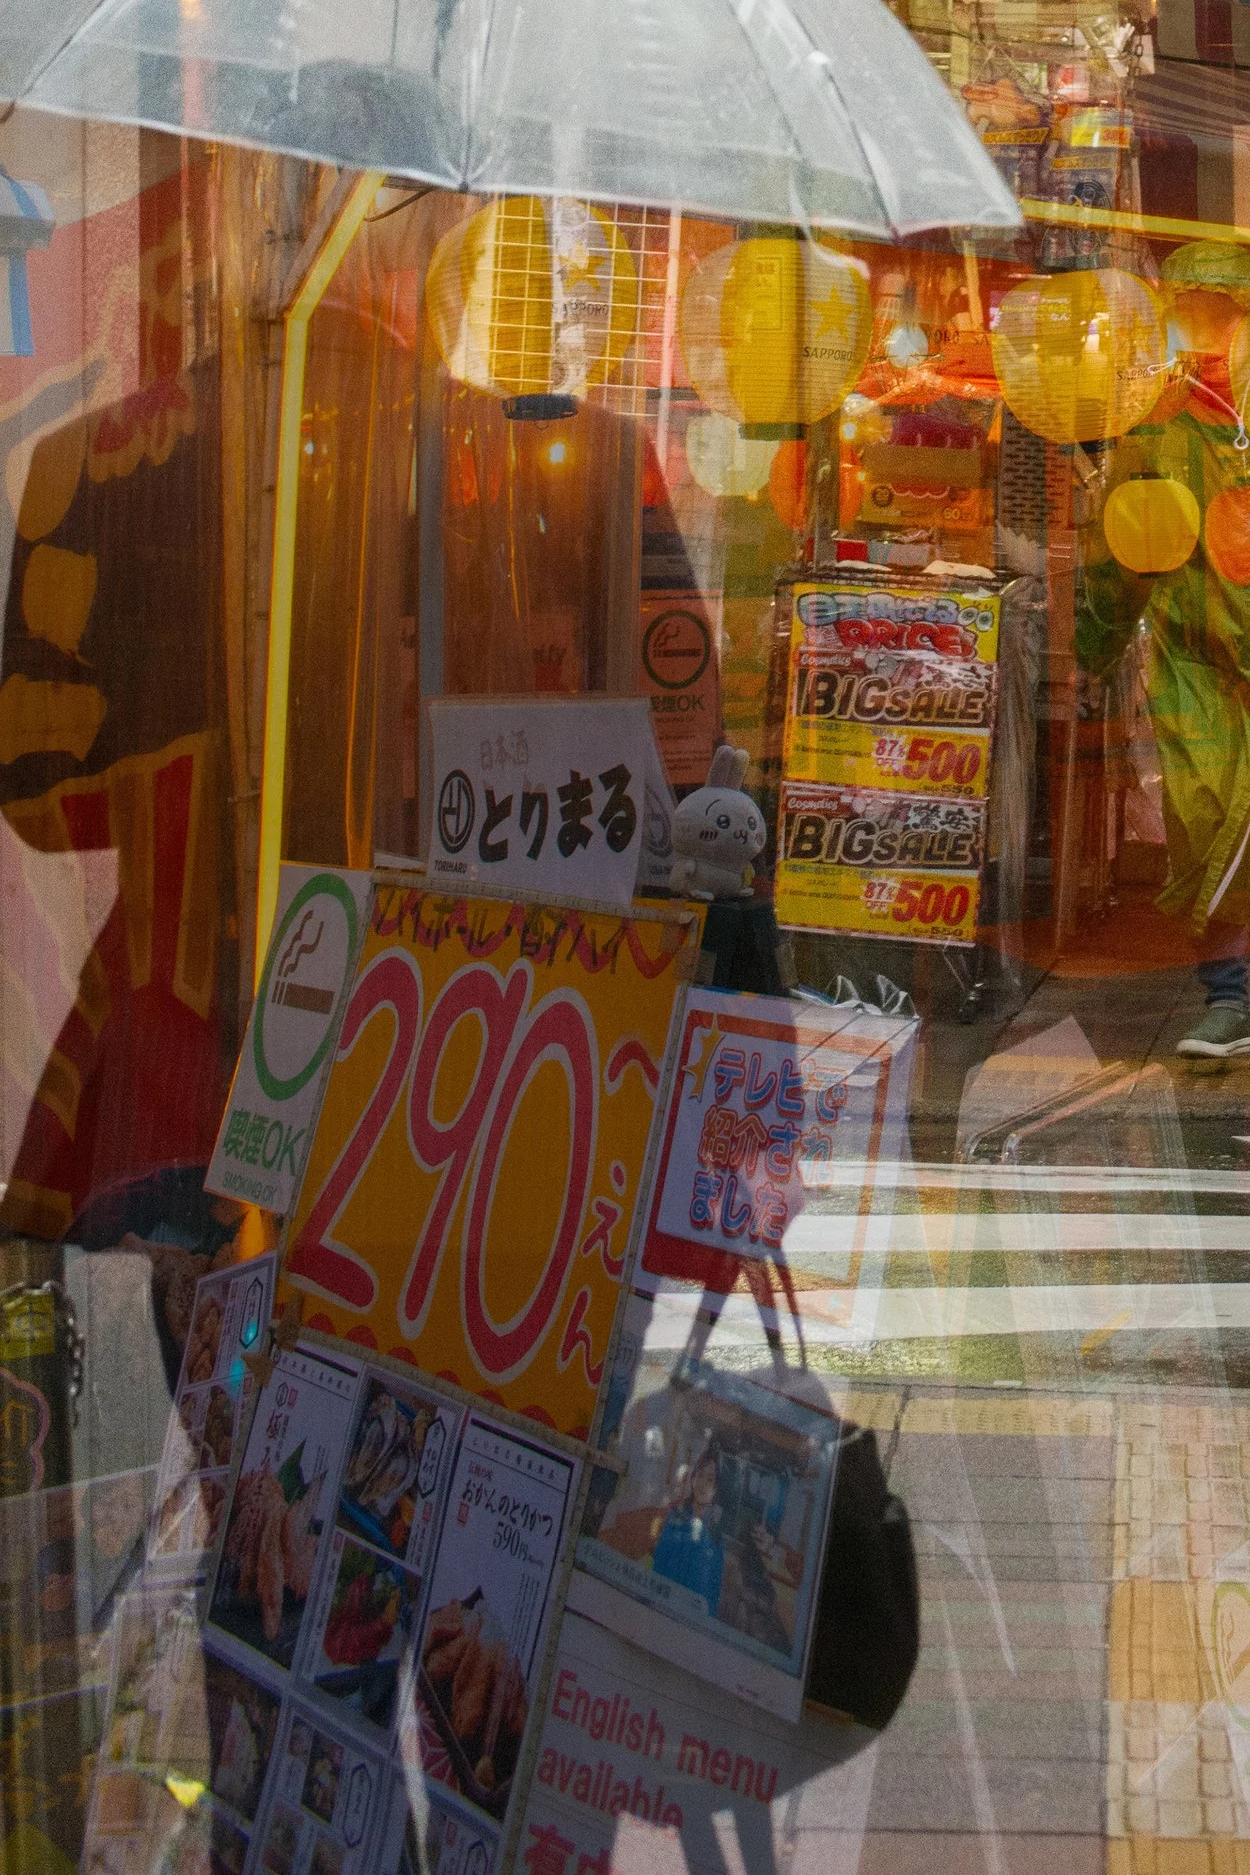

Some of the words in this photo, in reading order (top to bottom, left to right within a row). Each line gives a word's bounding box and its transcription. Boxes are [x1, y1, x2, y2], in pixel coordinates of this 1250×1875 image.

[803, 345, 854, 362] SAPPORO
[903, 737, 981, 784] 500
[477, 762, 638, 863] とりまる
[892, 880, 970, 926] 500
[712, 1046, 850, 1120] テレビで
[222, 1109, 306, 1177] 喫煙OK
[286, 955, 598, 1375] 290
[700, 1104, 834, 1193] 紹介され
[690, 1170, 788, 1246] ました
[551, 1668, 666, 1762] English
[677, 1731, 779, 1805] menu
